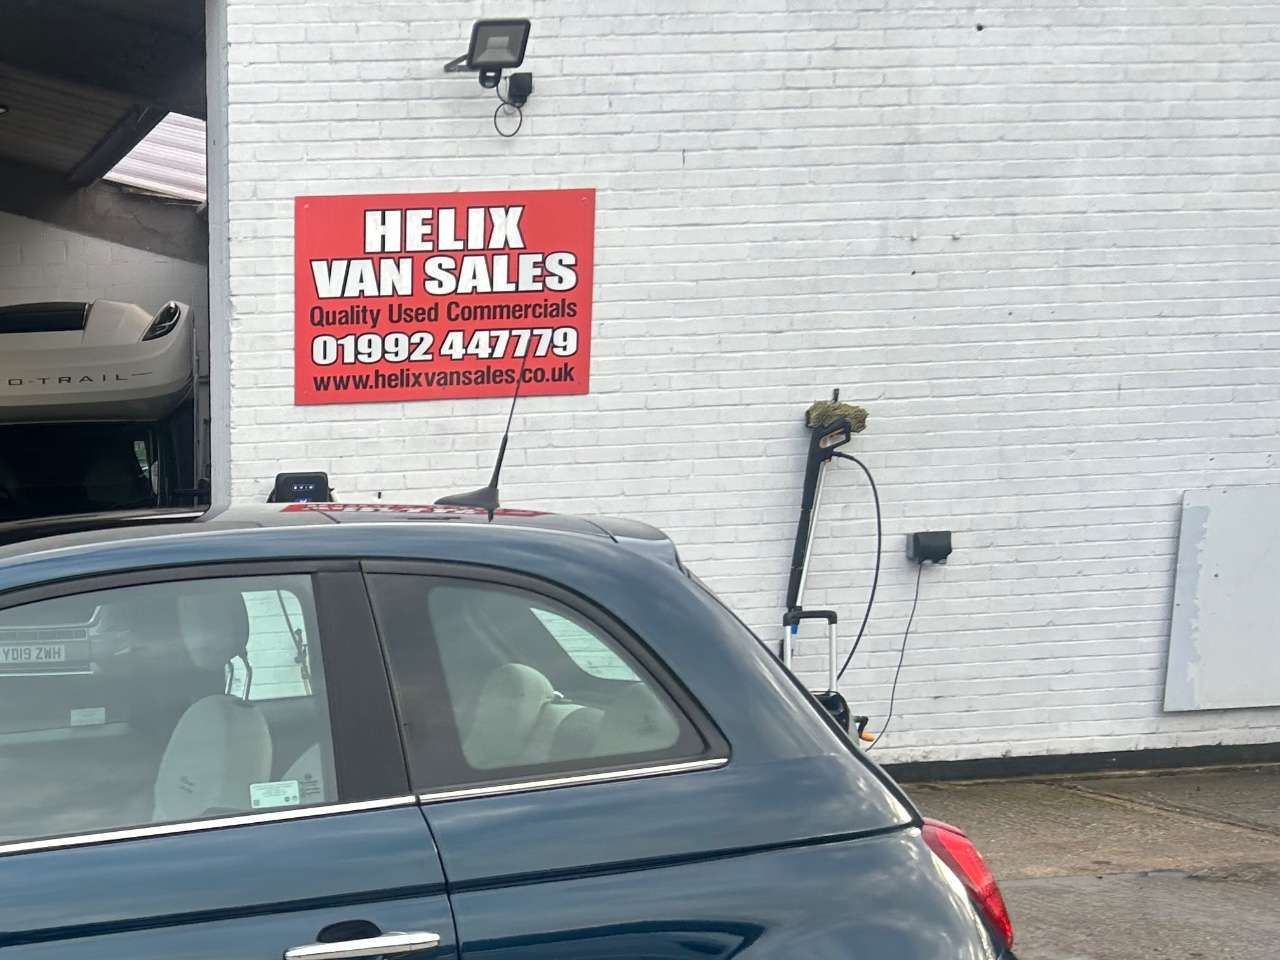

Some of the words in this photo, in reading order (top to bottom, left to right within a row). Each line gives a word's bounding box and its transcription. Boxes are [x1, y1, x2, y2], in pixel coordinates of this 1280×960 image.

[364, 205, 526, 254] HELIX
[310, 256, 414, 299] VAN
[422, 251, 578, 297] SALES
[309, 305, 380, 329] Quality
[388, 302, 439, 324] Used
[446, 298, 578, 322] Commercials
[311, 331, 435, 366] 01992
[439, 327, 579, 362] 447779
[313, 362, 575, 392] www.helixvansales.co.uk
[35, 647, 61, 660] ZWH
